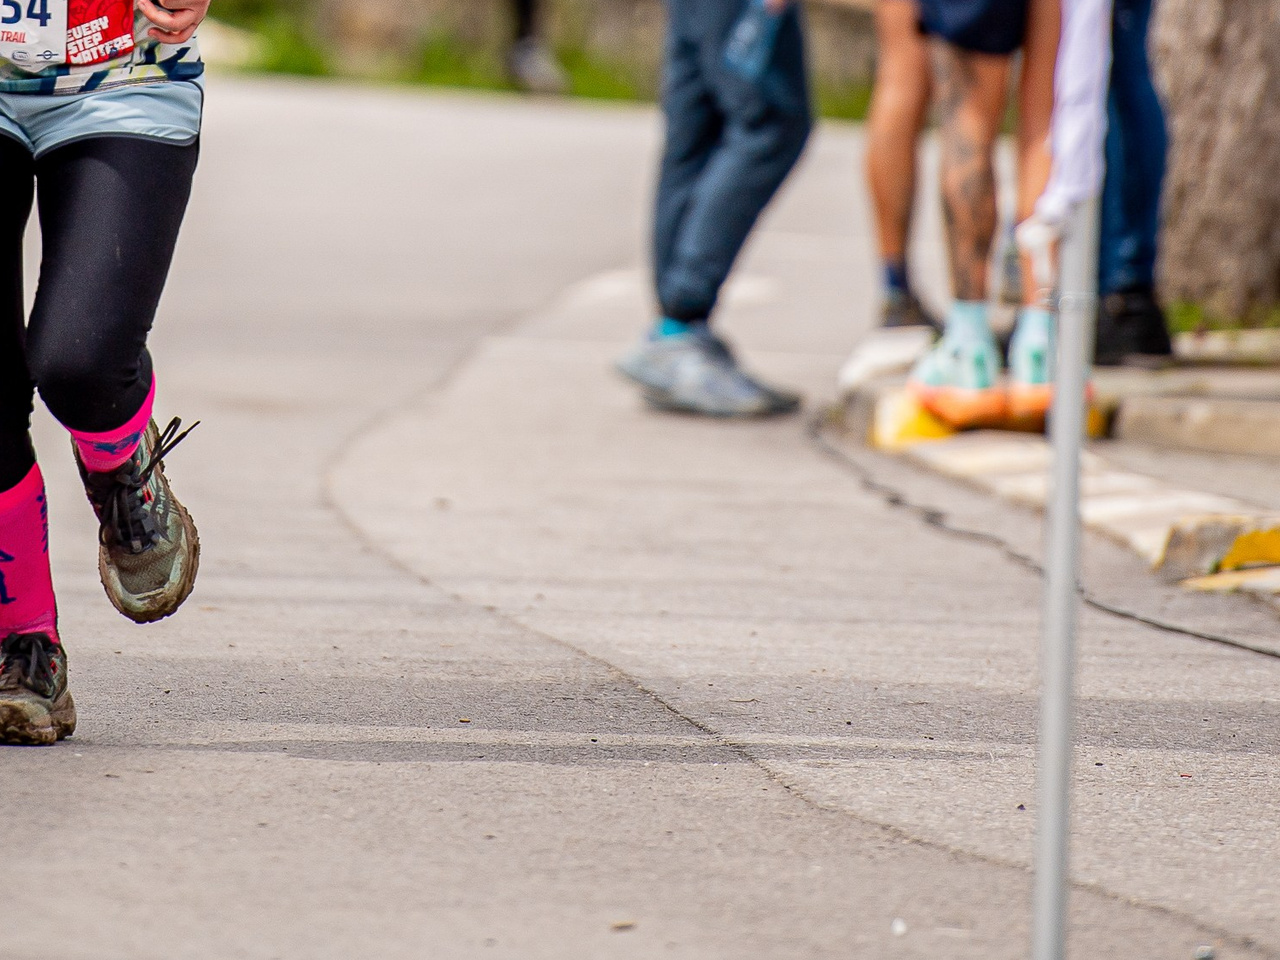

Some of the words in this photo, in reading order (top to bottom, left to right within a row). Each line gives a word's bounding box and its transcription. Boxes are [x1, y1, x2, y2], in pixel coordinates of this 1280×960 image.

[1, 30, 27, 43] TRAIL
[67, 15, 109, 42] EVERY
[67, 32, 103, 55] STEP
[70, 33, 134, 64] MATTERS
